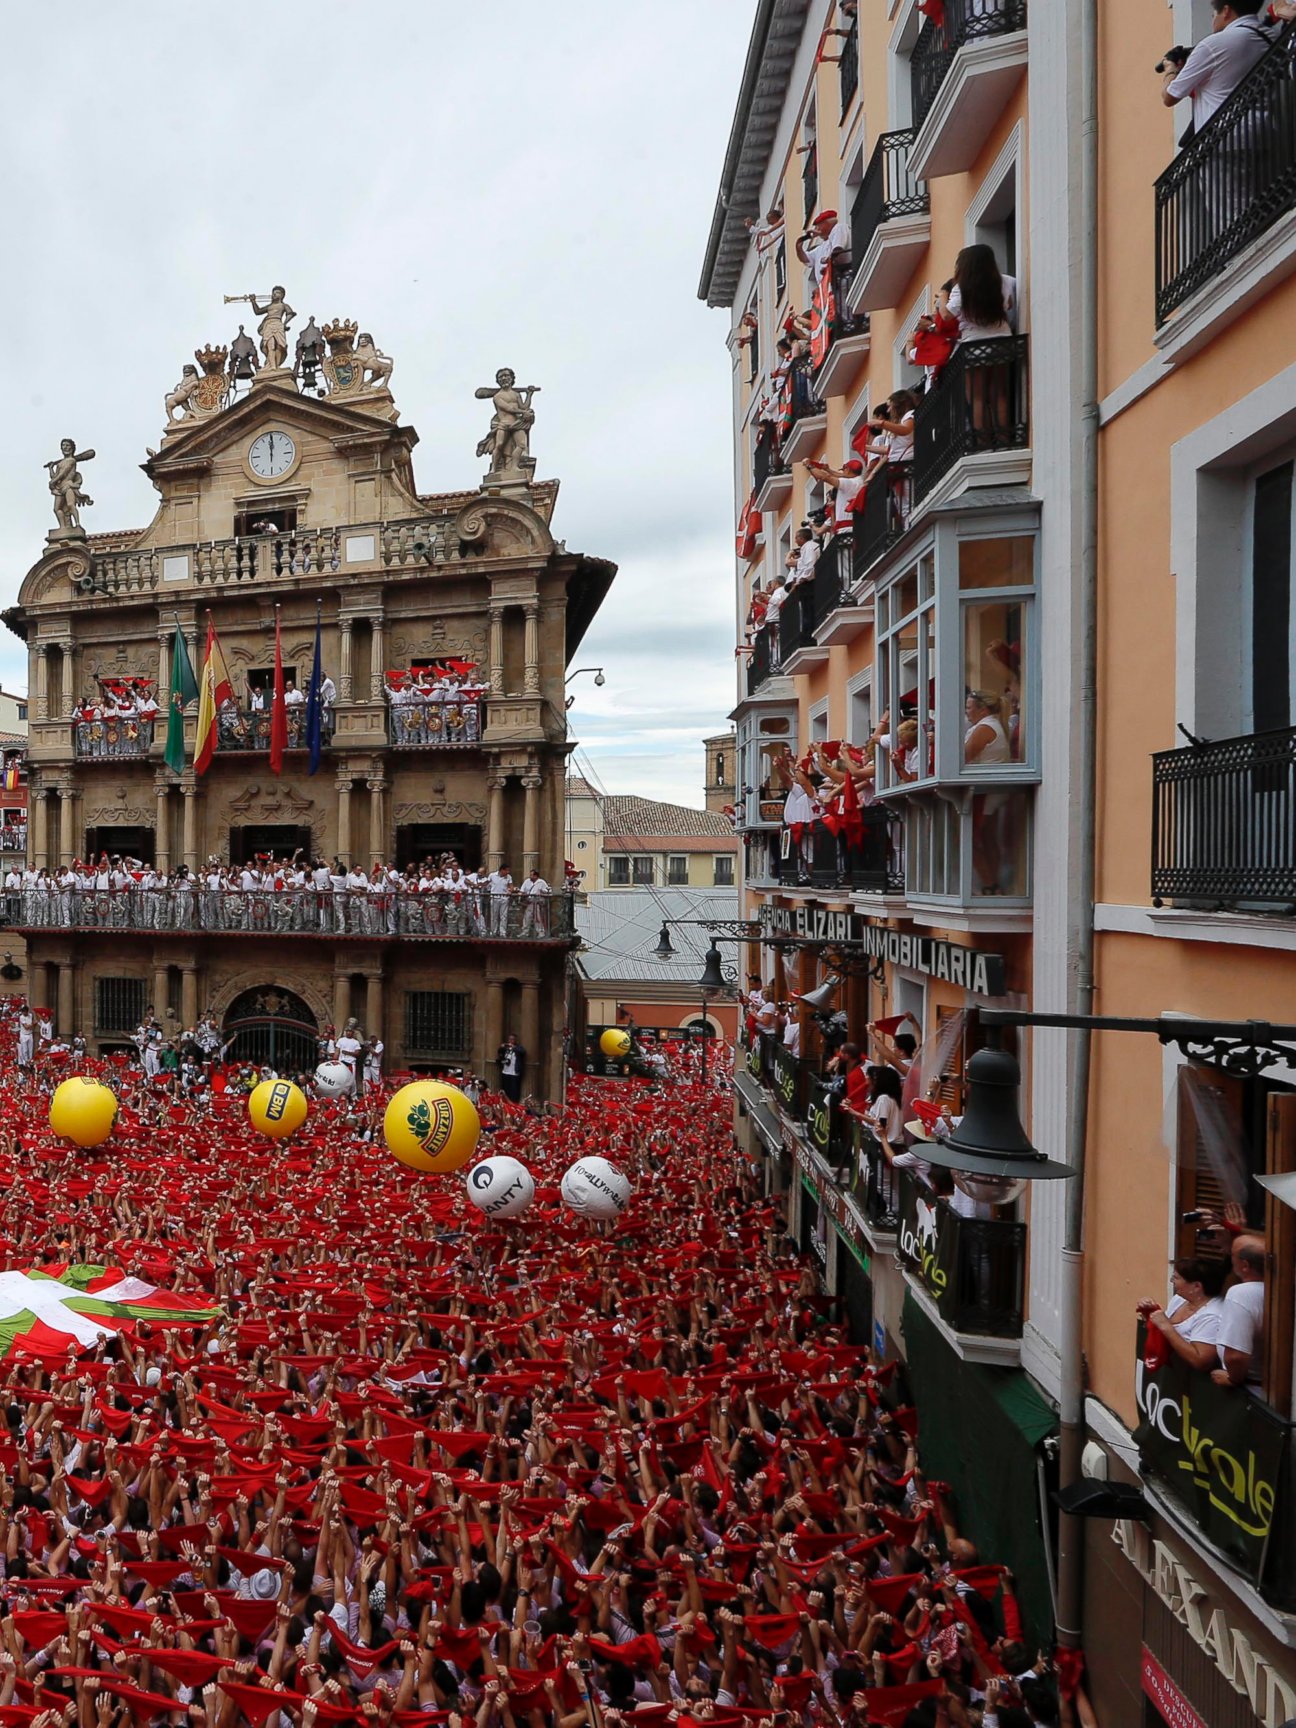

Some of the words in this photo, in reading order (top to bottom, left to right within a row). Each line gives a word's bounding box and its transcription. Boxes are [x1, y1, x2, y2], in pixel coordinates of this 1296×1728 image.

[795, 907, 852, 941] ELIZARI
[863, 925, 989, 996] INMOBILIARIA
[425, 1101, 452, 1153] URZANTE
